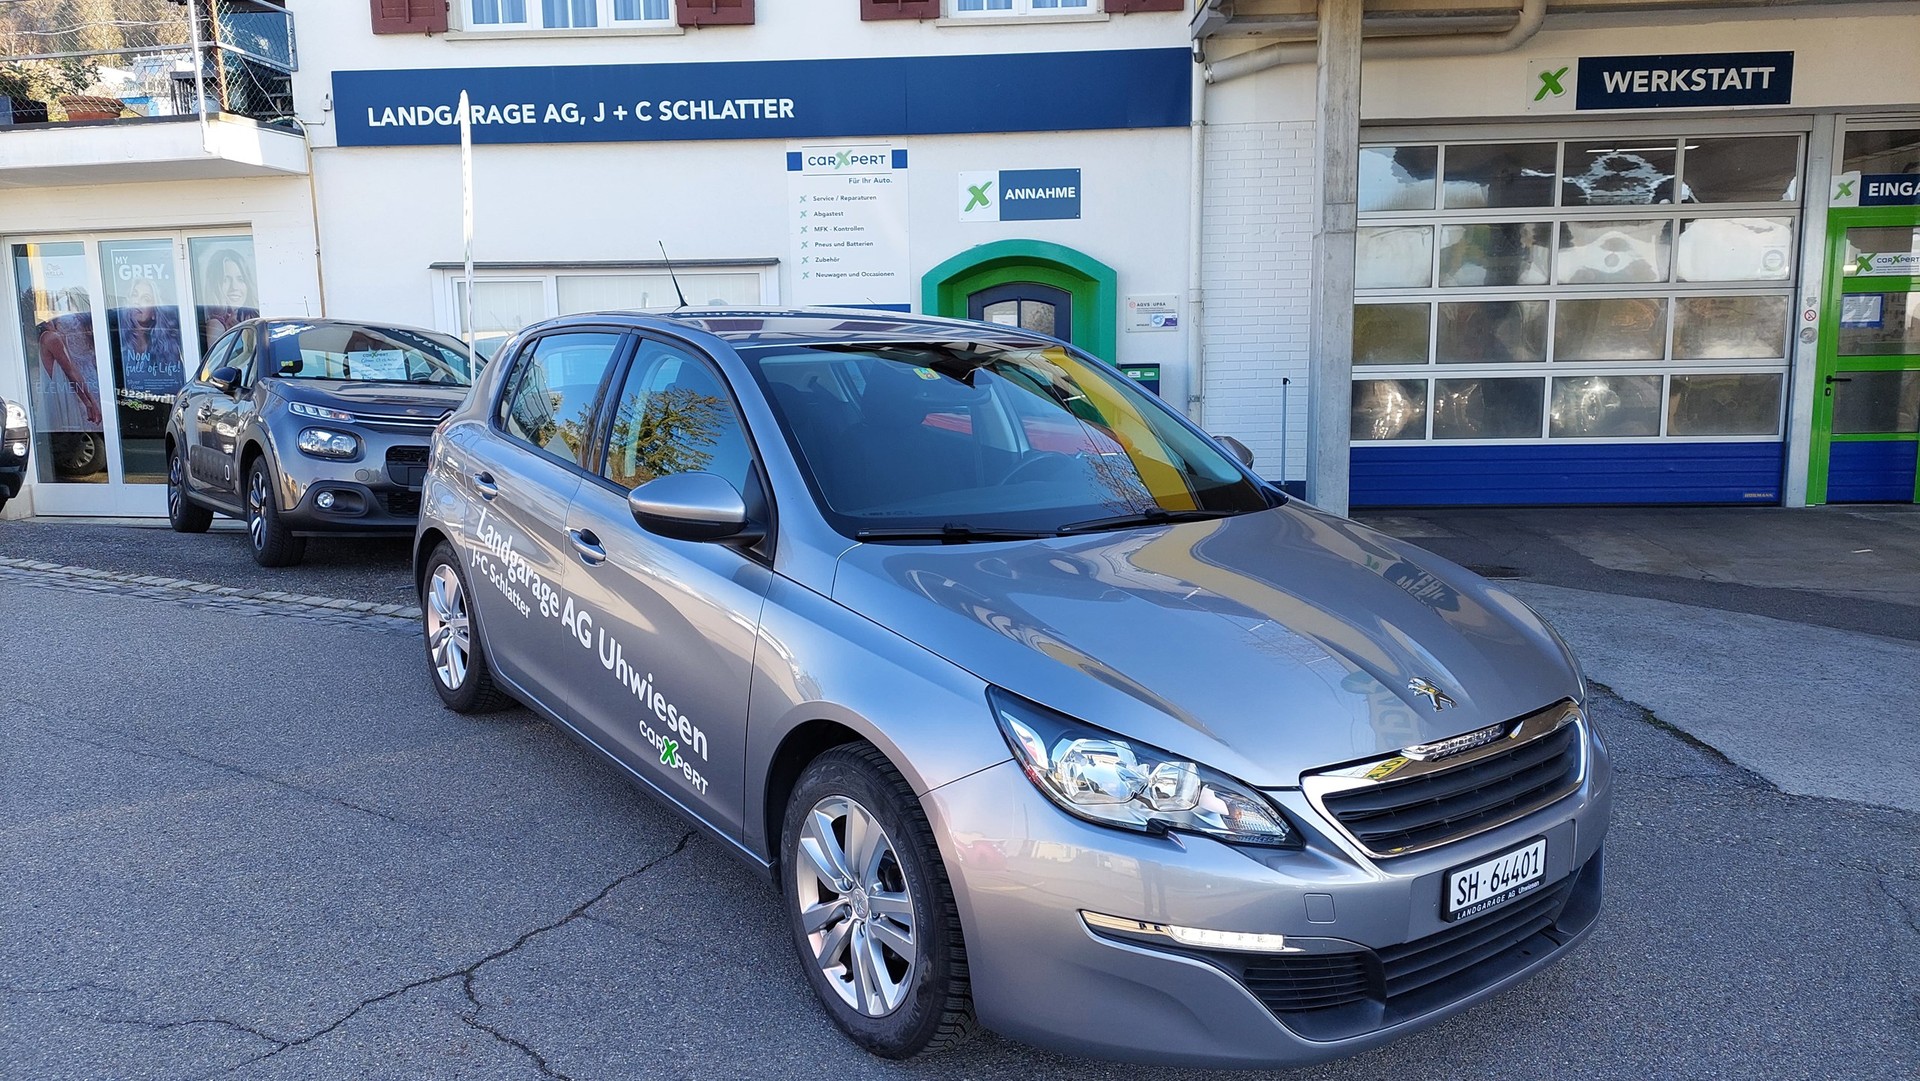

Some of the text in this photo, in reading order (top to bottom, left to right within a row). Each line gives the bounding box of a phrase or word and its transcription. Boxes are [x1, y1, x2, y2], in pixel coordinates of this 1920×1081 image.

[1603, 66, 1776, 94] WERKSTATT
[543, 102, 586, 126] AG,
[593, 102, 605, 123] J
[613, 105, 628, 121] +
[635, 101, 653, 121] C
[658, 98, 795, 121] SCHLATTER
[1004, 186, 1076, 200] ANNAHME
[813, 210, 844, 218] Abgastest
[115, 256, 128, 265] MY
[119, 263, 169, 281] GREY.
[127, 349, 151, 362] Now
[125, 362, 145, 377] full
[147, 363, 158, 377] of
[36, 381, 99, 394] ELEMENTS
[489, 565, 531, 620] Schlatter
[475, 507, 708, 762] Landgarage AG Uhwiesen
[1457, 894, 1506, 920] LANDGARAGE
